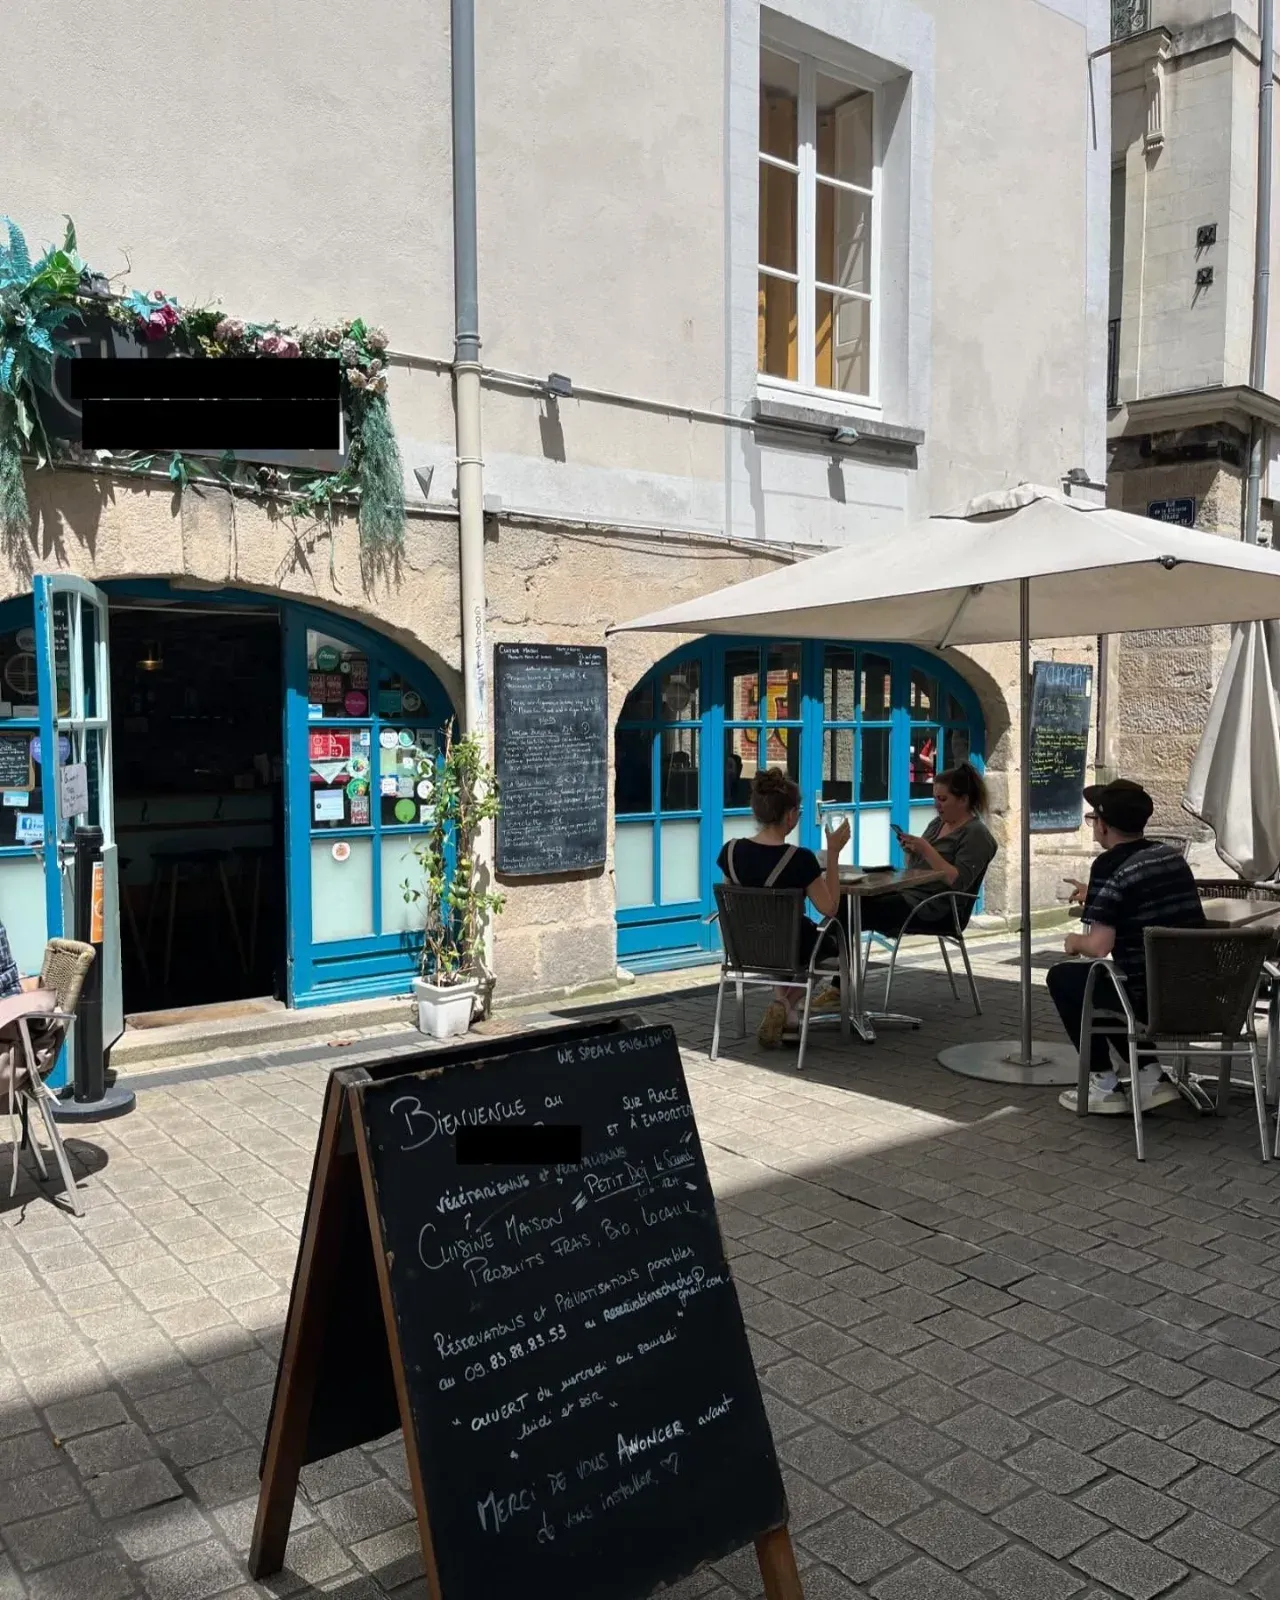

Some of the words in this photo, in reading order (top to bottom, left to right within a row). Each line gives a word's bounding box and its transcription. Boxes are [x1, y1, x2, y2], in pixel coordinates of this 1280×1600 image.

[557, 1049, 575, 1064] WE
[579, 1042, 615, 1061] SPEAK
[618, 1035, 662, 1053] ENGLISH
[544, 1094, 563, 1108] au
[622, 1096, 643, 1110] SUR
[647, 1087, 679, 1104] PLACE
[606, 1123, 619, 1136] ET
[629, 1113, 638, 1130] À
[438, 1376, 456, 1391] au
[464, 1324, 568, 1381] 09.83.88.83.53
[536, 1386, 553, 1401] du
